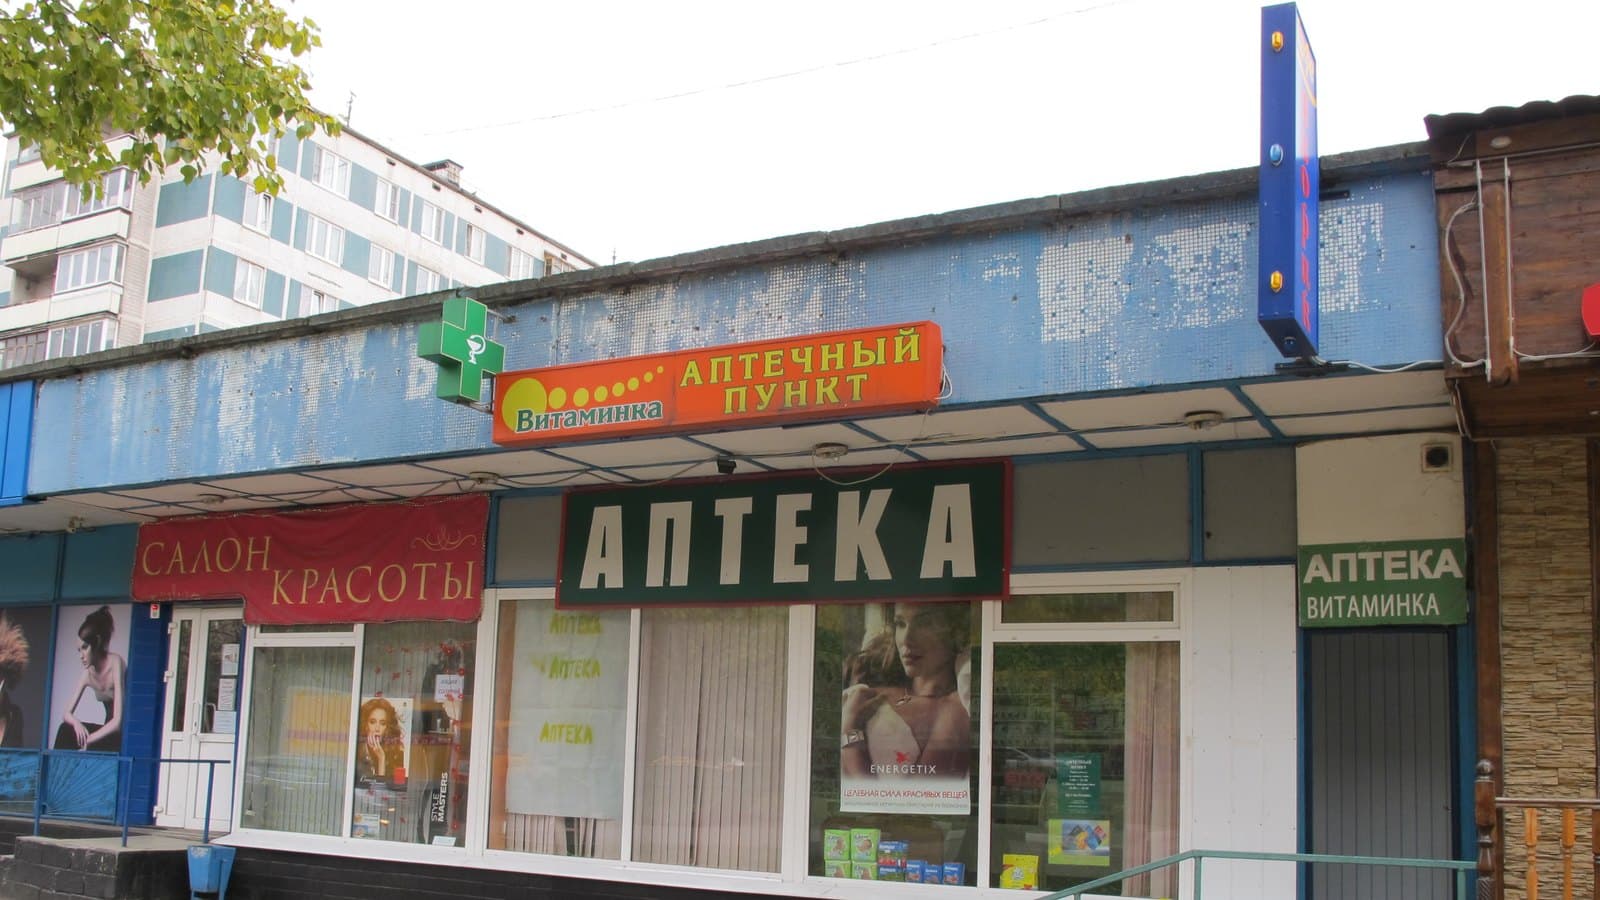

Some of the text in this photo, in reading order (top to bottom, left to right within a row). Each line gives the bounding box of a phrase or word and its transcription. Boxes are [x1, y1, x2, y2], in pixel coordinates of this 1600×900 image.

[680, 327, 920, 387] АПТЕЧНЫЙ
[723, 373, 868, 415] ПУНКТ
[514, 400, 664, 434] Витаминка
[579, 483, 977, 589] АПТЕКА
[142, 536, 271, 576] САЛОН
[1303, 548, 1464, 584] АПТЕКА
[271, 560, 475, 606] КРАСОТЫ
[1307, 593, 1440, 619] ВИТАМИНКА
[548, 655, 601, 679] АПТЕКА
[539, 720, 593, 744] АПТЕКА
[870, 764, 937, 775] ENERGETIX
[431, 792, 440, 822] STYLE
[438, 771, 449, 822] MASTERS
[880, 790, 902, 798] СИЛА
